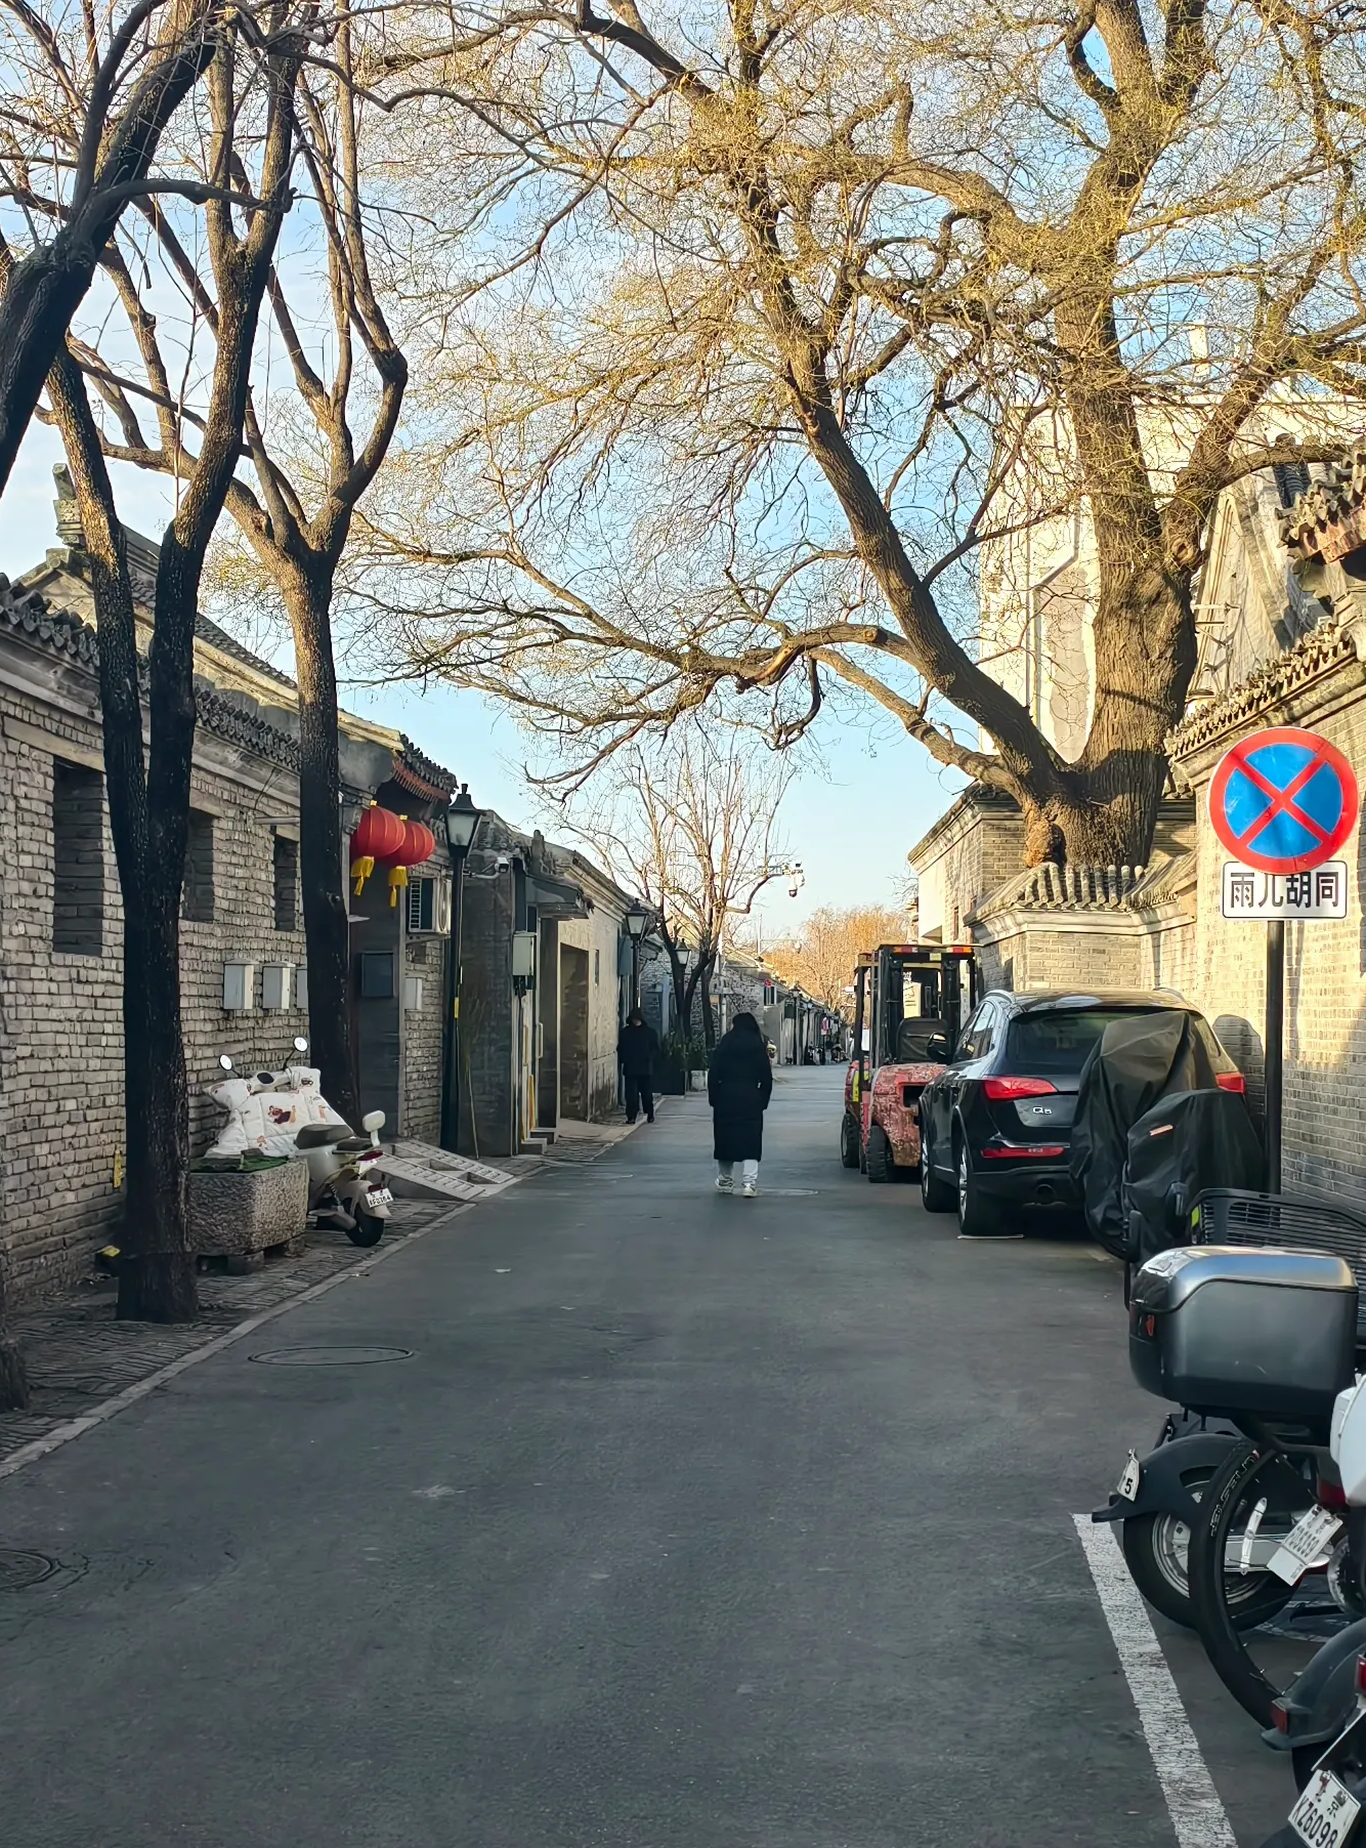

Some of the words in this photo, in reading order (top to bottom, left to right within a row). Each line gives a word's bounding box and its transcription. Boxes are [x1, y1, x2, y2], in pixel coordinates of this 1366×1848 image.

[1230, 871, 1339, 908] 雨儿胡同
[1032, 1106, 1052, 1115] Q5
[1292, 1795, 1339, 1848] KZ6098
